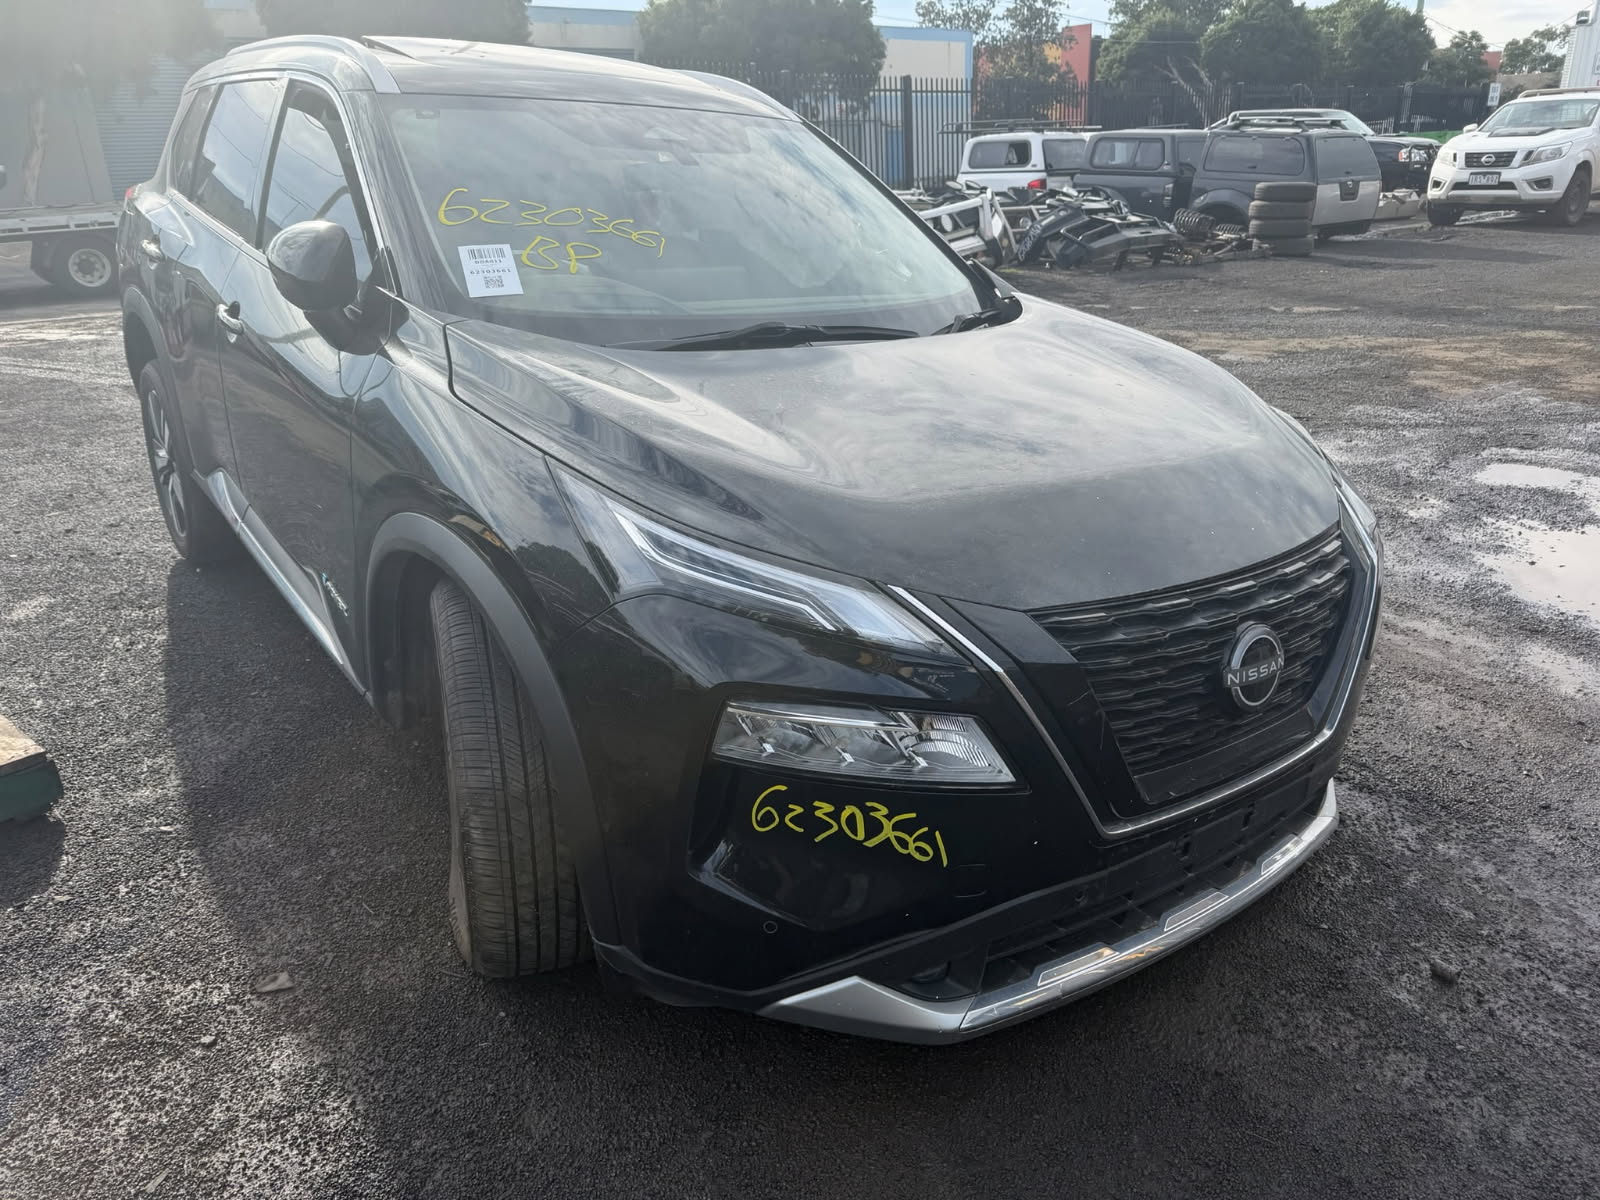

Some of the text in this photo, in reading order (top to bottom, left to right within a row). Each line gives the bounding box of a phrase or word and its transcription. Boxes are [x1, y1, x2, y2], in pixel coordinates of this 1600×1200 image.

[438, 188, 665, 258] 62303661
[1227, 657, 1284, 686] NISSAN
[751, 784, 948, 868] 62303661
